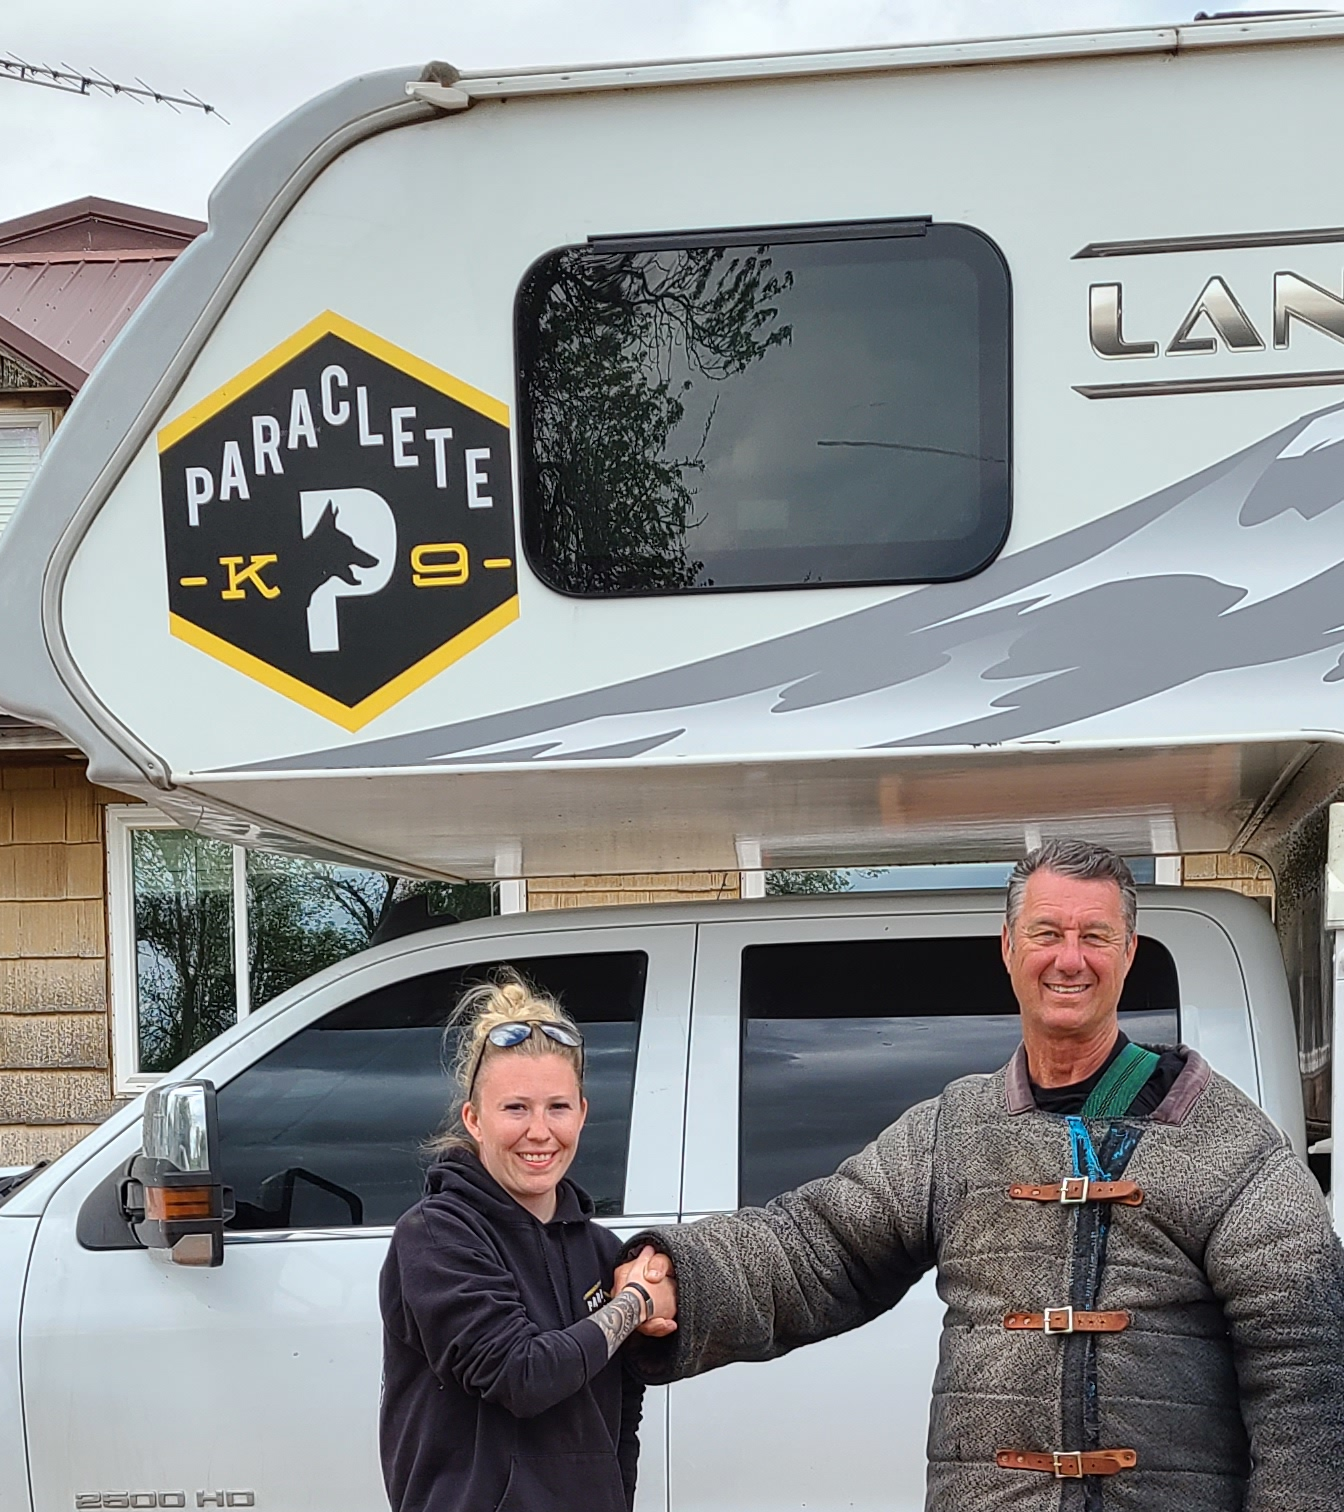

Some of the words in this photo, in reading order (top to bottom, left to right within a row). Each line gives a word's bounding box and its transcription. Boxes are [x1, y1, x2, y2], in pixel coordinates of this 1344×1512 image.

[184, 364, 494, 527] PARACLETE
[75, 1490, 185, 1509] 2500
[196, 1489, 255, 1508] HD
